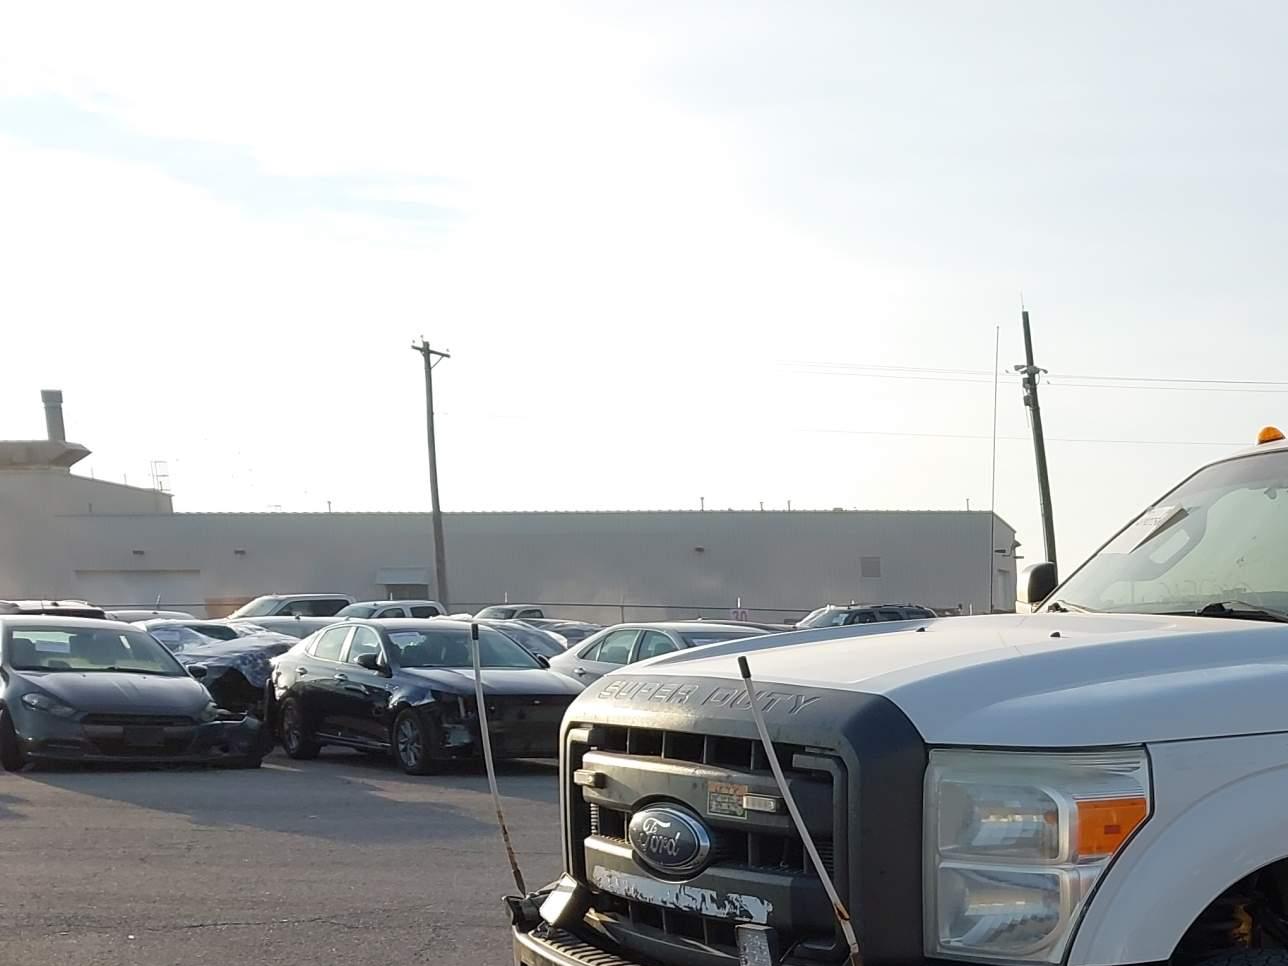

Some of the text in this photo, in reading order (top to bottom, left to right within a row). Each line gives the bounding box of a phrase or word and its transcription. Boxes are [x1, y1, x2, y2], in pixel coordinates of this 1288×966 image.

[598, 680, 821, 714] SUPER DUTY
[639, 816, 681, 857] Ford
